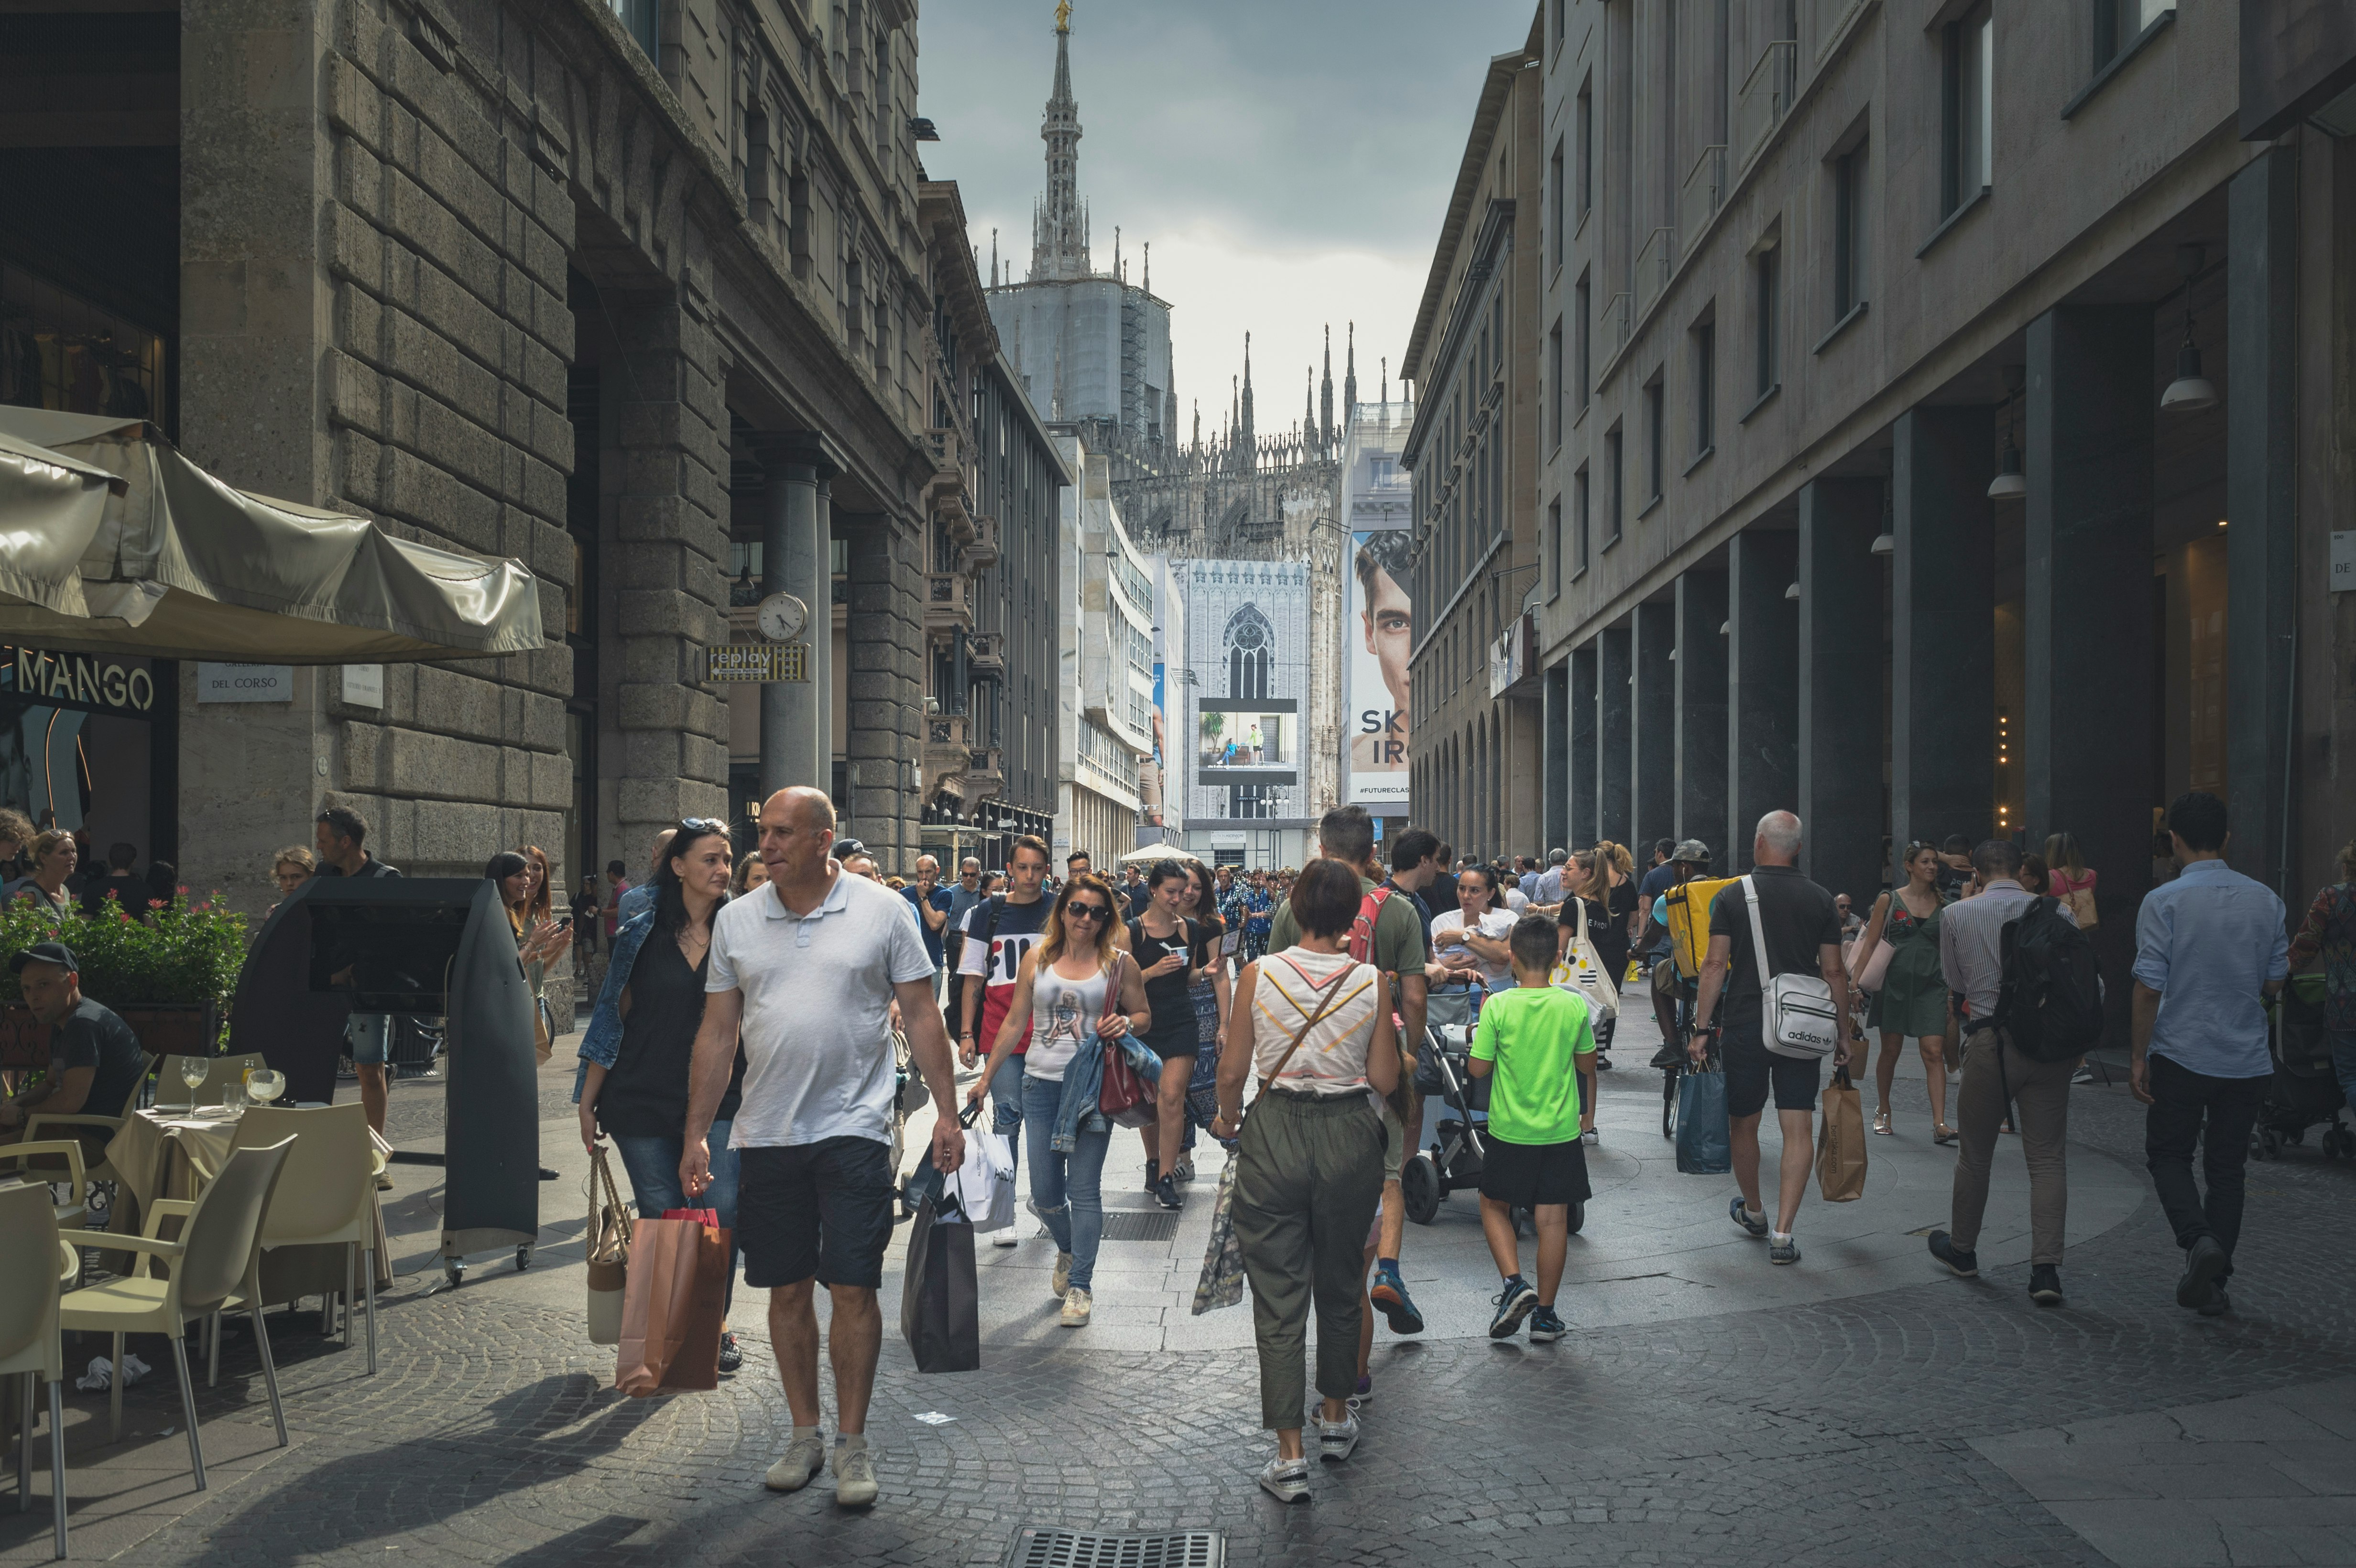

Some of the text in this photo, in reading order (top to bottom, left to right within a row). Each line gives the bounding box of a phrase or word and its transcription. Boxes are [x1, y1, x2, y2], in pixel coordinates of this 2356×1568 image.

[2335, 563, 2351, 574] DE
[710, 649, 772, 667] replay
[19, 647, 153, 711] MANGO
[212, 677, 277, 688] DEL CORSO
[1362, 710, 1405, 733] SK
[1374, 740, 1409, 763] IR
[1788, 1031, 1822, 1044] adidas
[1831, 1124, 1839, 1174] bershka.com
